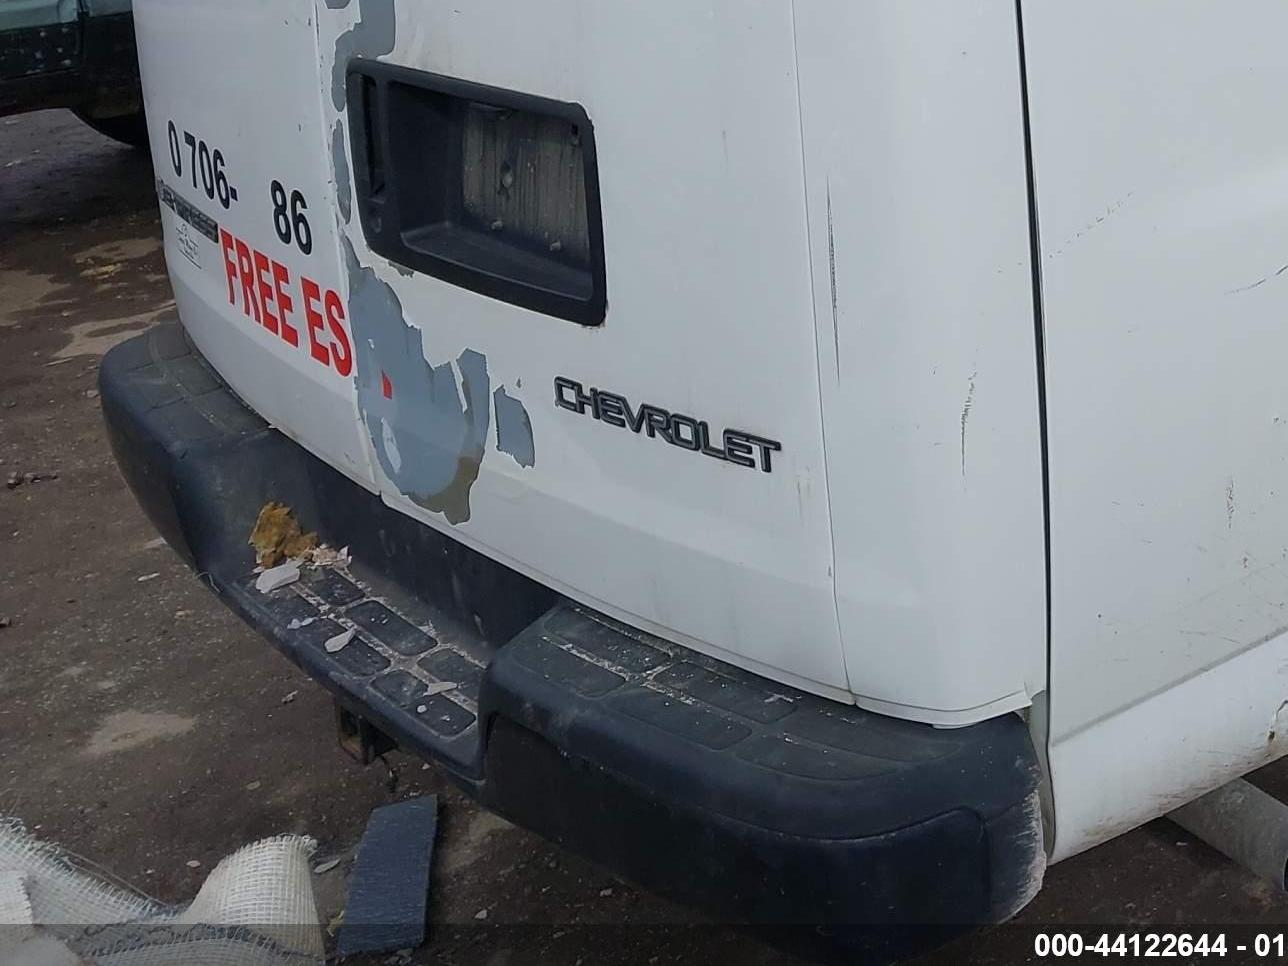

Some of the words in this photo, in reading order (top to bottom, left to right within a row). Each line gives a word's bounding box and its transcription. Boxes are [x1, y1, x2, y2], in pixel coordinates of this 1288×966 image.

[270, 179, 312, 256] 86
[220, 227, 299, 349] FREE
[301, 276, 353, 377] ES
[554, 376, 782, 473] CHEVROLET
